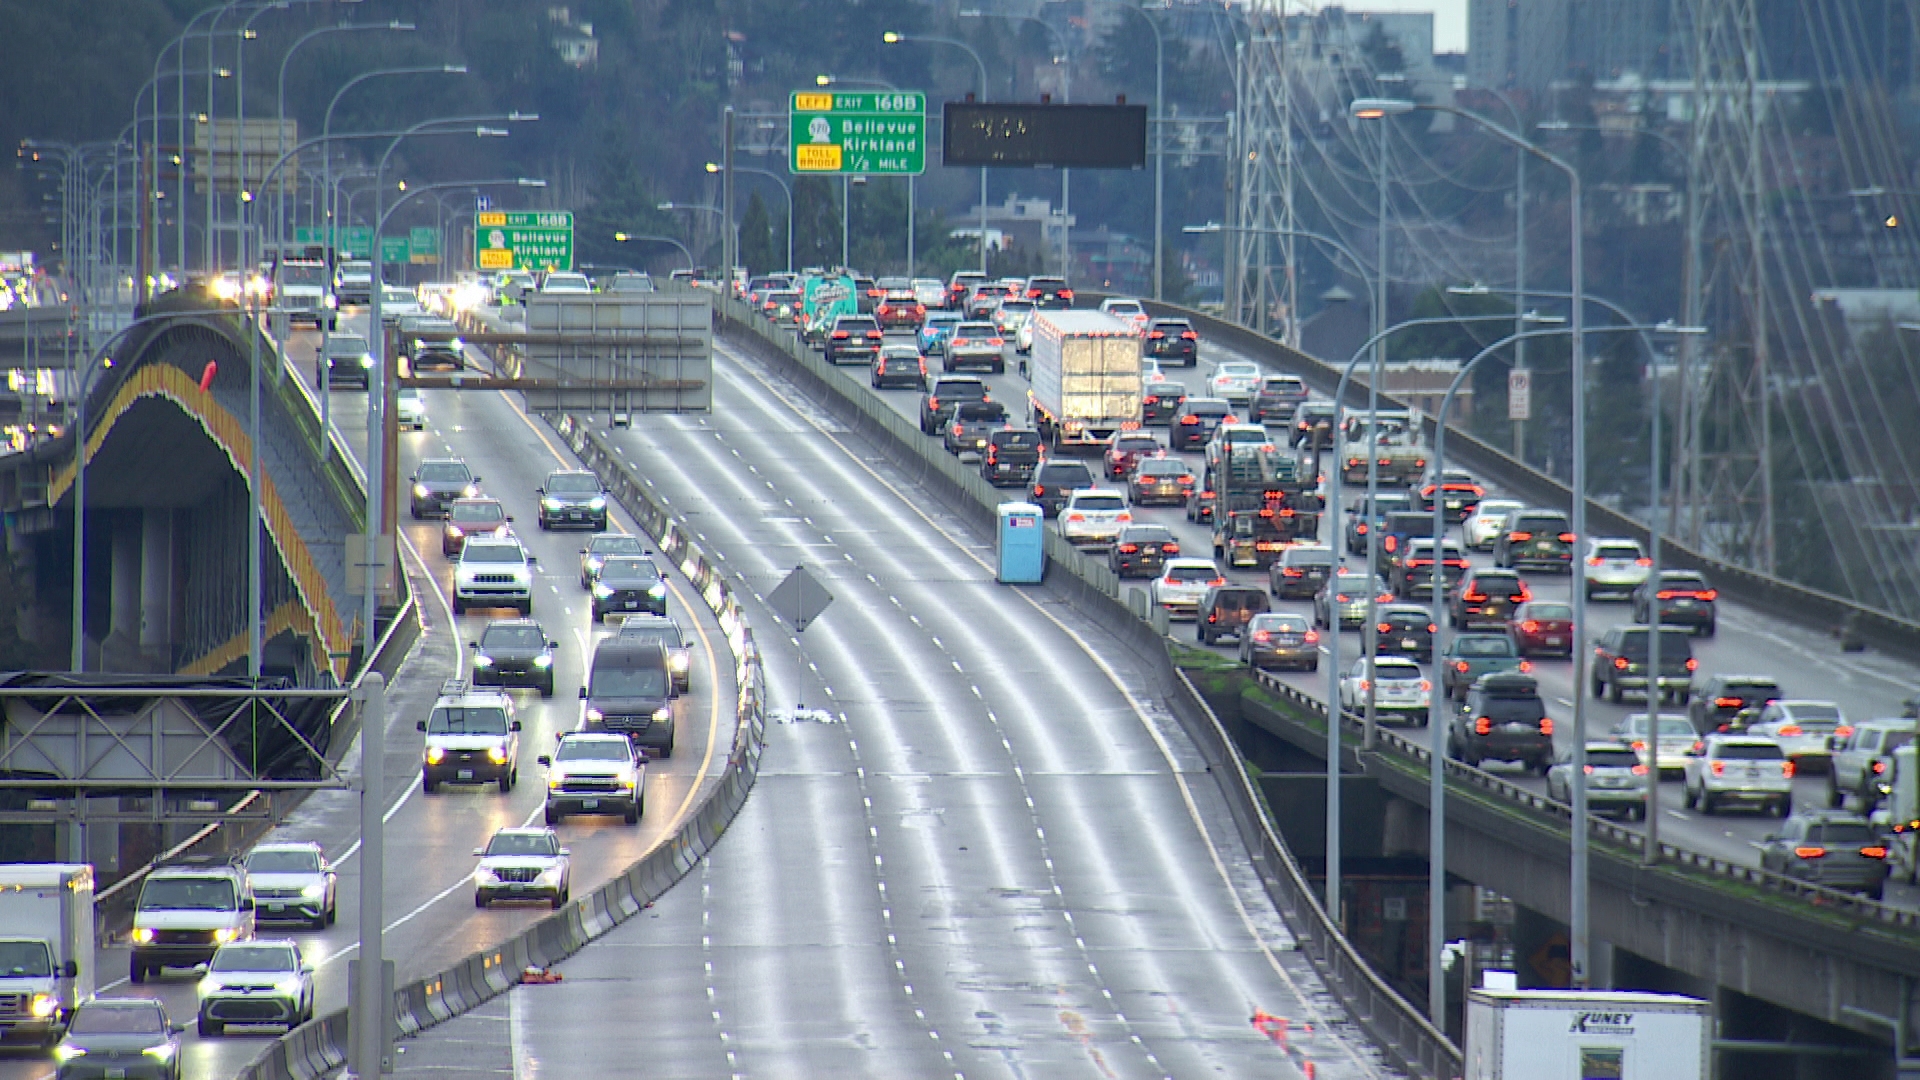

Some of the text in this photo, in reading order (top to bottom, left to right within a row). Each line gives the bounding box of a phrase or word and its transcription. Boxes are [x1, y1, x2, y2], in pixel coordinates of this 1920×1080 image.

[798, 94, 916, 110] LEFT EXIT 168B
[842, 119, 916, 134] Bellevue
[843, 137, 916, 152] Kirkland
[806, 149, 832, 157] TOLL
[799, 158, 836, 167] BRIDGE
[850, 154, 908, 170] 1/2 MILE
[508, 215, 528, 225] EXIT
[512, 231, 567, 243] Bellevue
[513, 244, 566, 256] Kirkland
[1568, 1011, 1634, 1033] KUNEY
